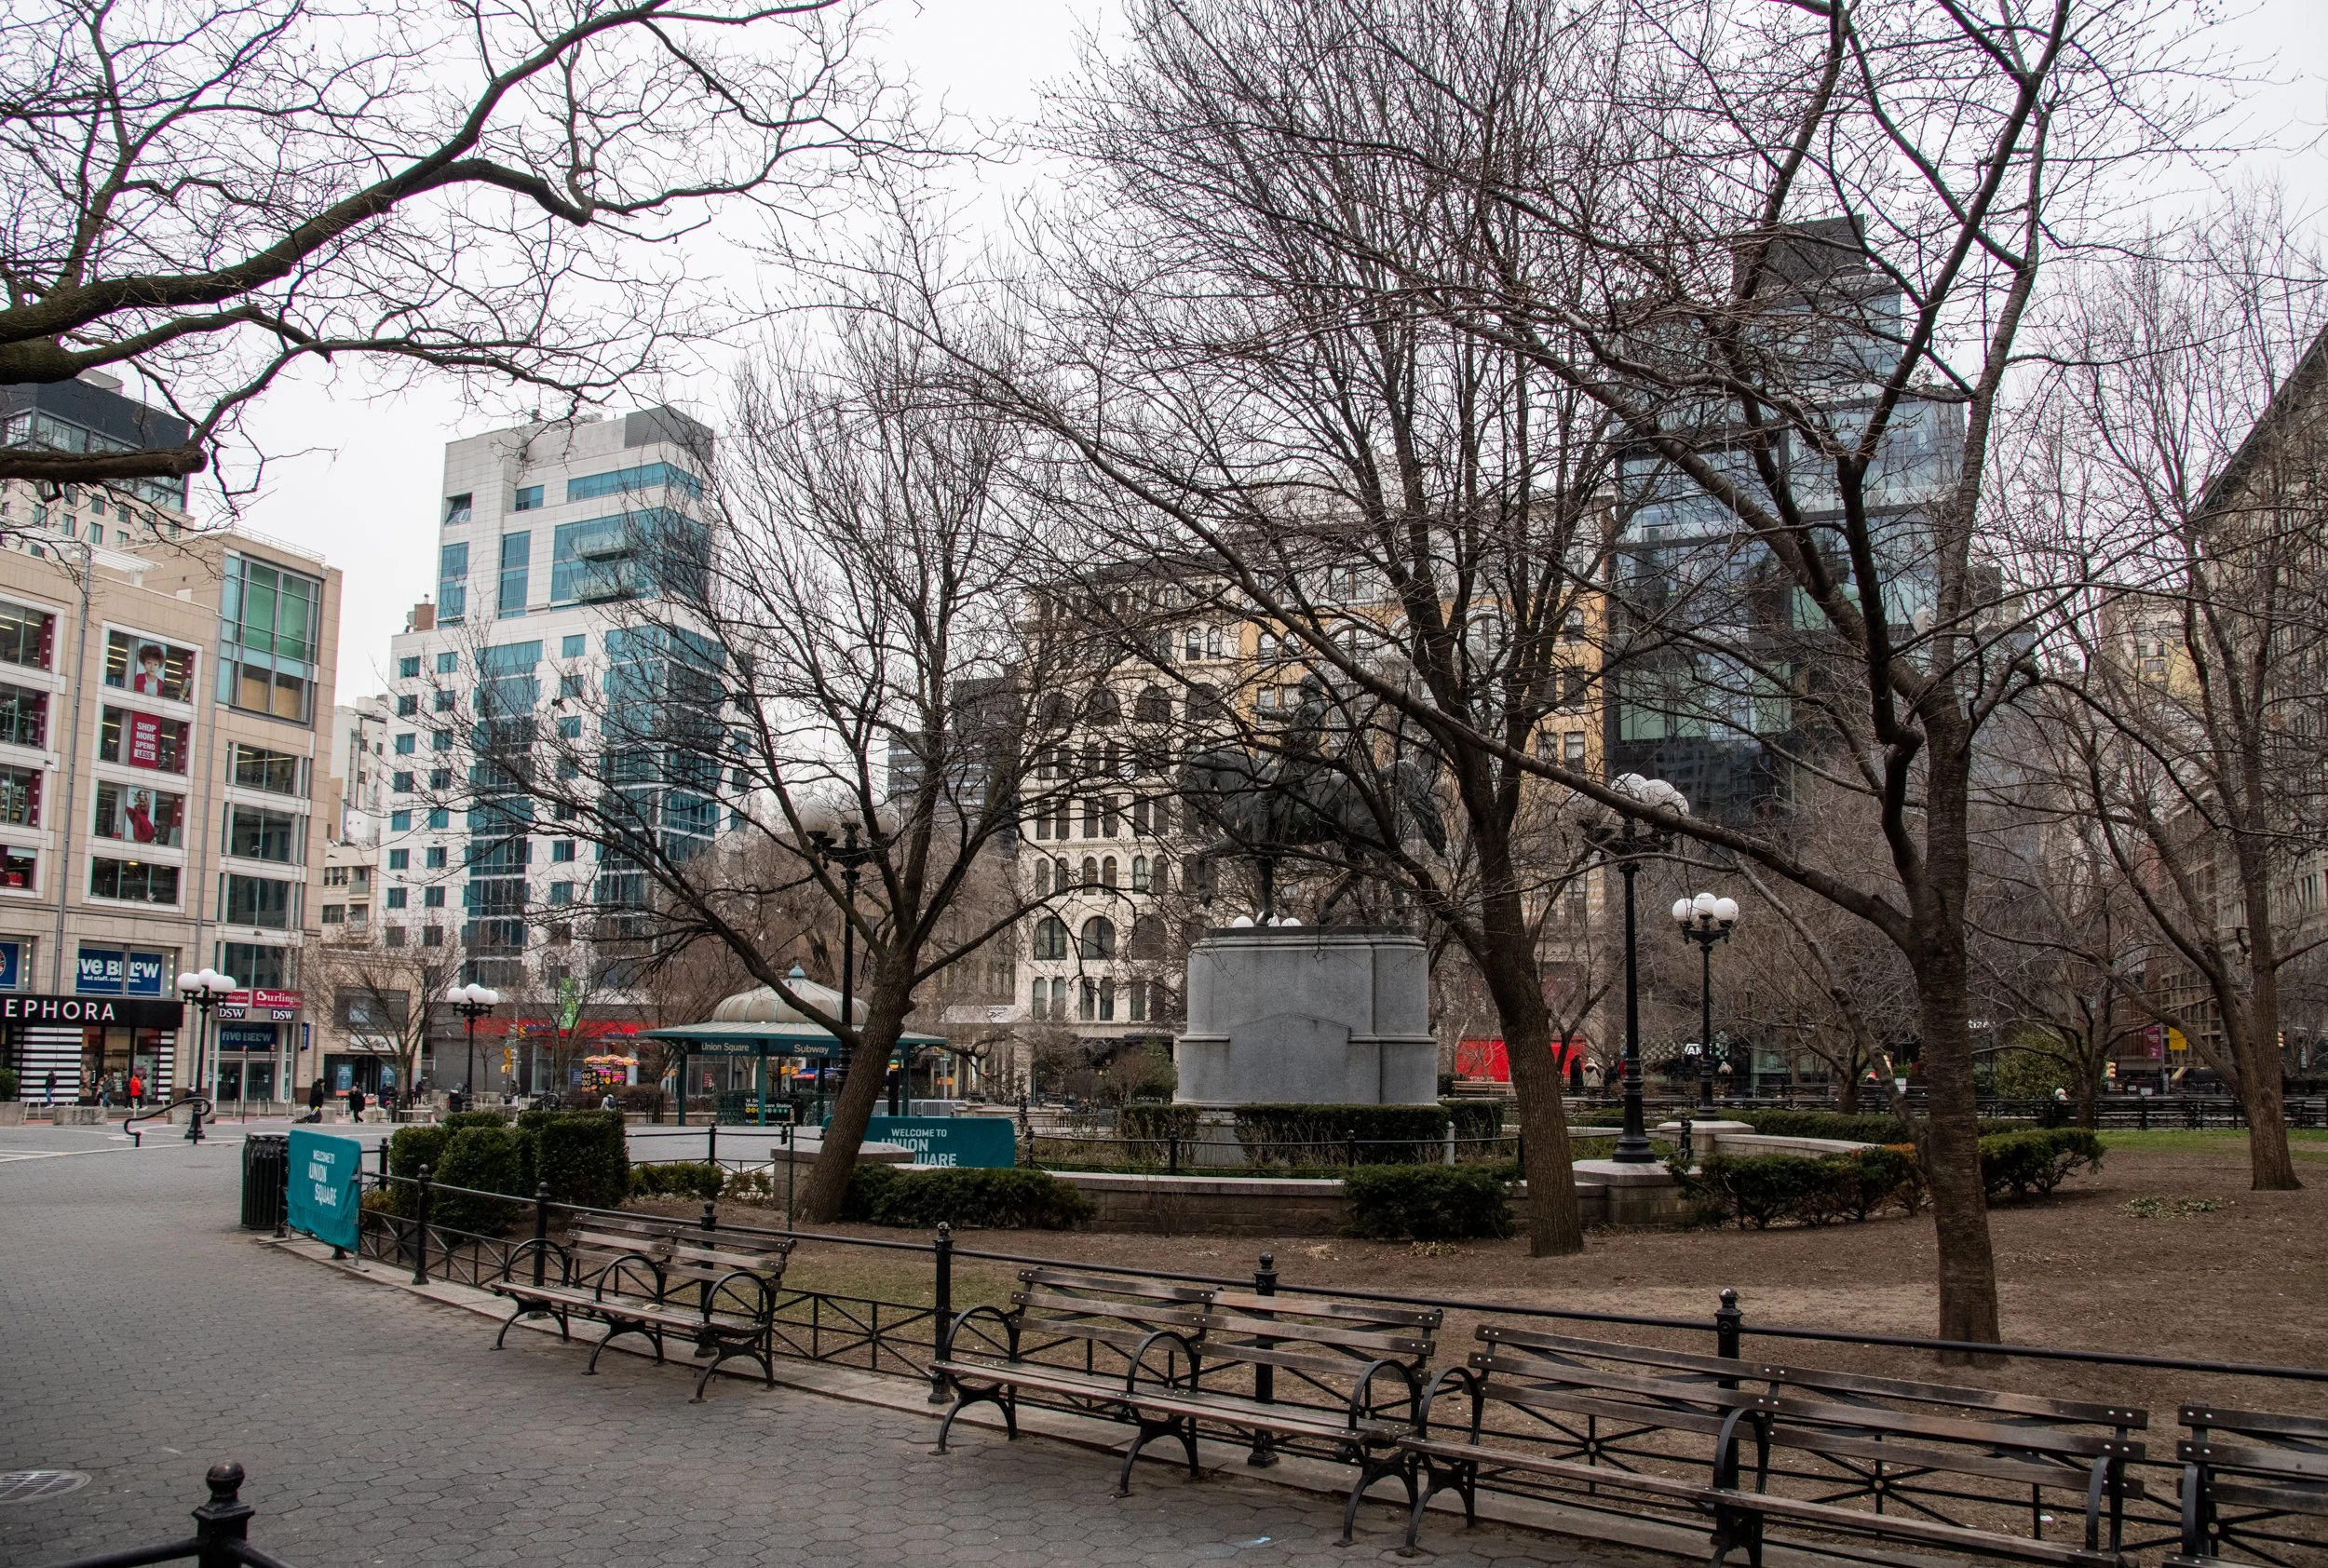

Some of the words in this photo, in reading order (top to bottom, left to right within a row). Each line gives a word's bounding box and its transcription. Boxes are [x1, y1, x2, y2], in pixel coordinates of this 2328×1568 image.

[137, 722, 156, 732] SHOP
[136, 731, 156, 742] MORE
[135, 740, 156, 750] SPEND
[137, 750, 153, 759] LESS
[5, 998, 115, 1021] EPHORA
[219, 1008, 245, 1018] DSW
[272, 1010, 294, 1021] DSW
[222, 1031, 242, 1041] five
[700, 1042, 722, 1050] Union
[724, 1042, 750, 1052] Square
[793, 1044, 830, 1054] Subway
[890, 1128, 935, 1137] WELCOME
[936, 1129, 947, 1138] TO
[313, 1149, 331, 1164] WELCOME
[914, 1153, 957, 1167] UARE
[308, 1161, 328, 1183] UNION
[315, 1183, 337, 1206] SQUARE
